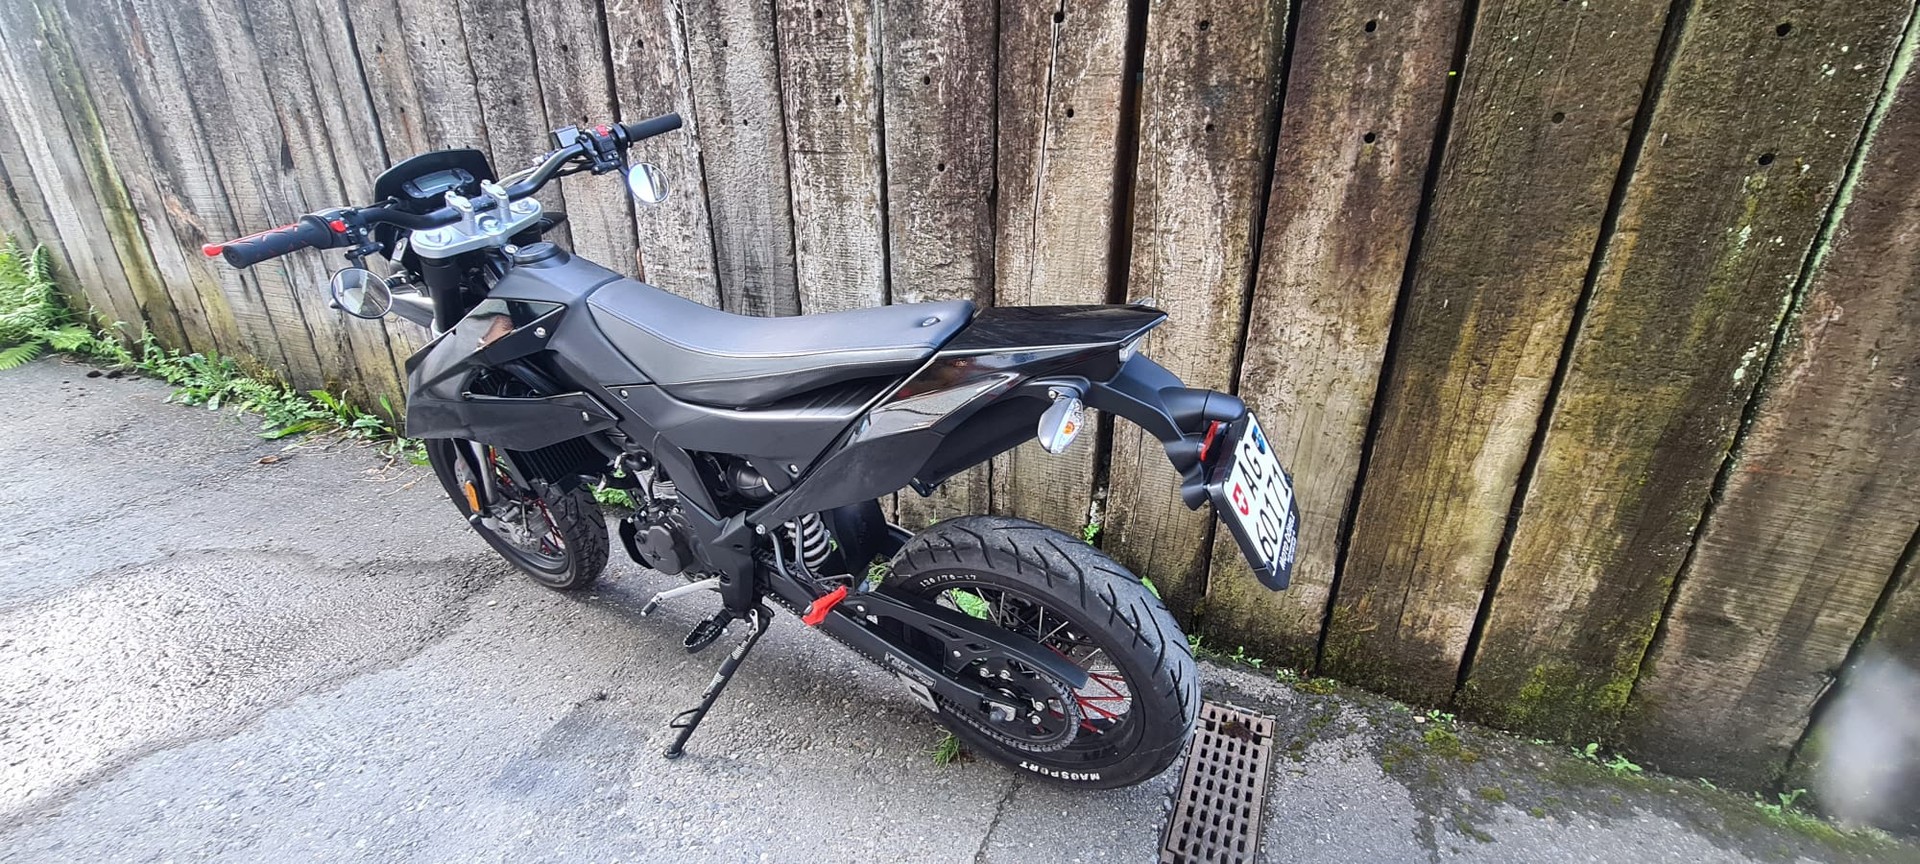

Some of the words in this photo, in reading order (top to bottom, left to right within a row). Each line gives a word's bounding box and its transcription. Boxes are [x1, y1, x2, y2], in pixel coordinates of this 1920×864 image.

[1239, 443, 1262, 500] AG
[1256, 463, 1289, 562] 60171
[1019, 760, 1101, 781] MAGSPORT
